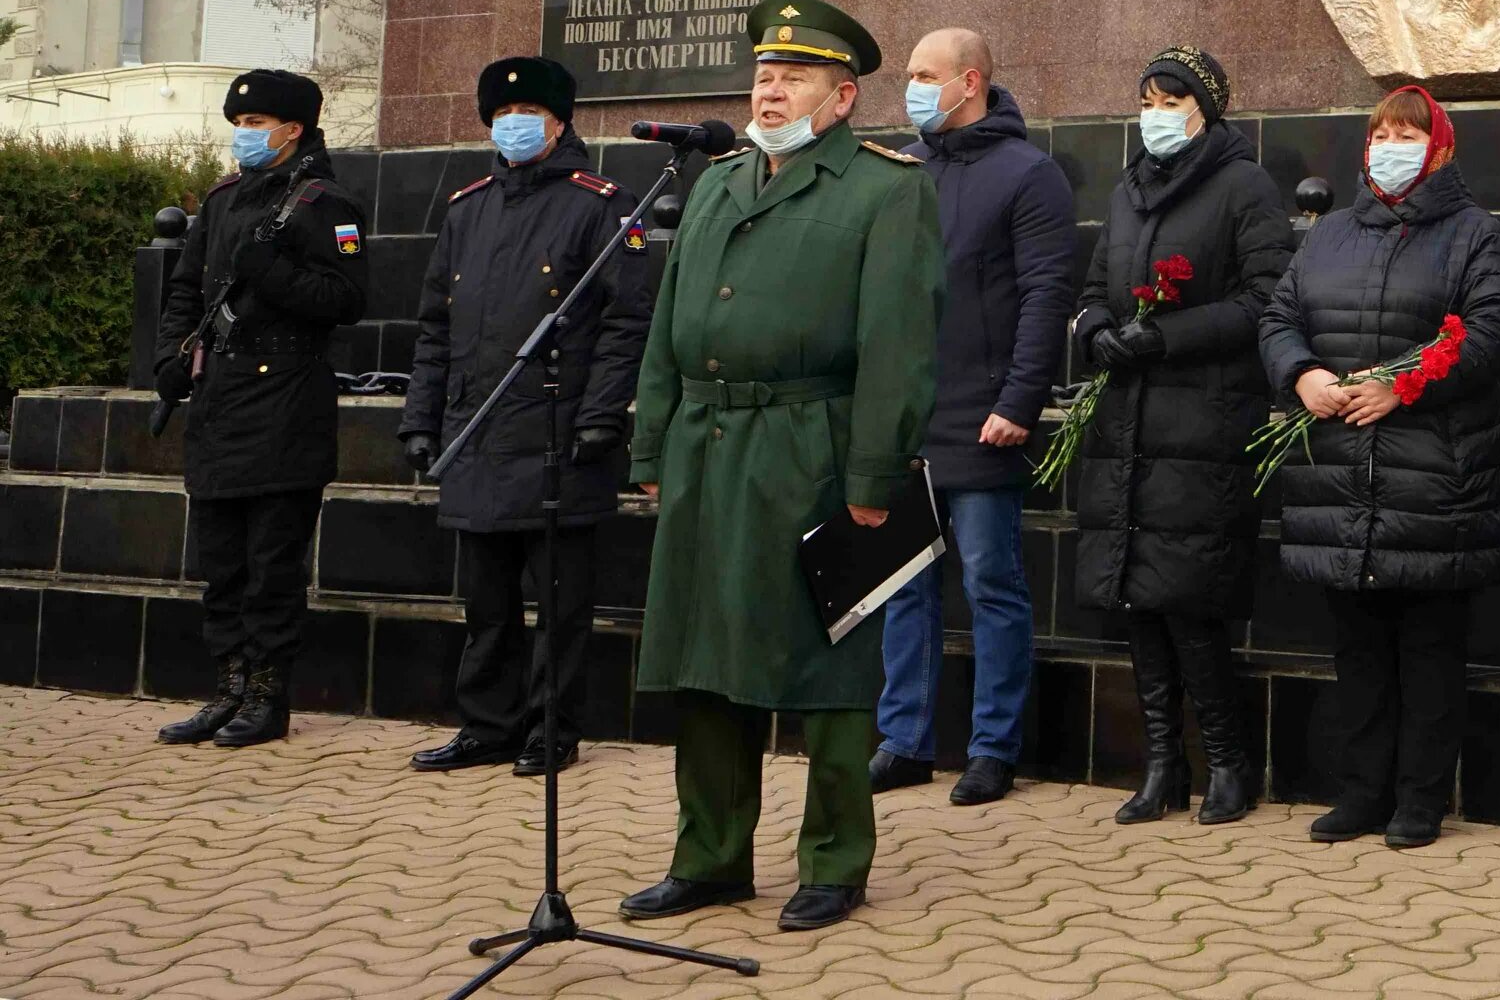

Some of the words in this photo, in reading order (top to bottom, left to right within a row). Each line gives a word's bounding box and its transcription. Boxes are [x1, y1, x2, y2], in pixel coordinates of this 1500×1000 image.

[636, 17, 673, 41] ИМЯ
[685, 12, 748, 38] КОТОРО
[597, 40, 738, 73] БЕССМЕРТИЕ
